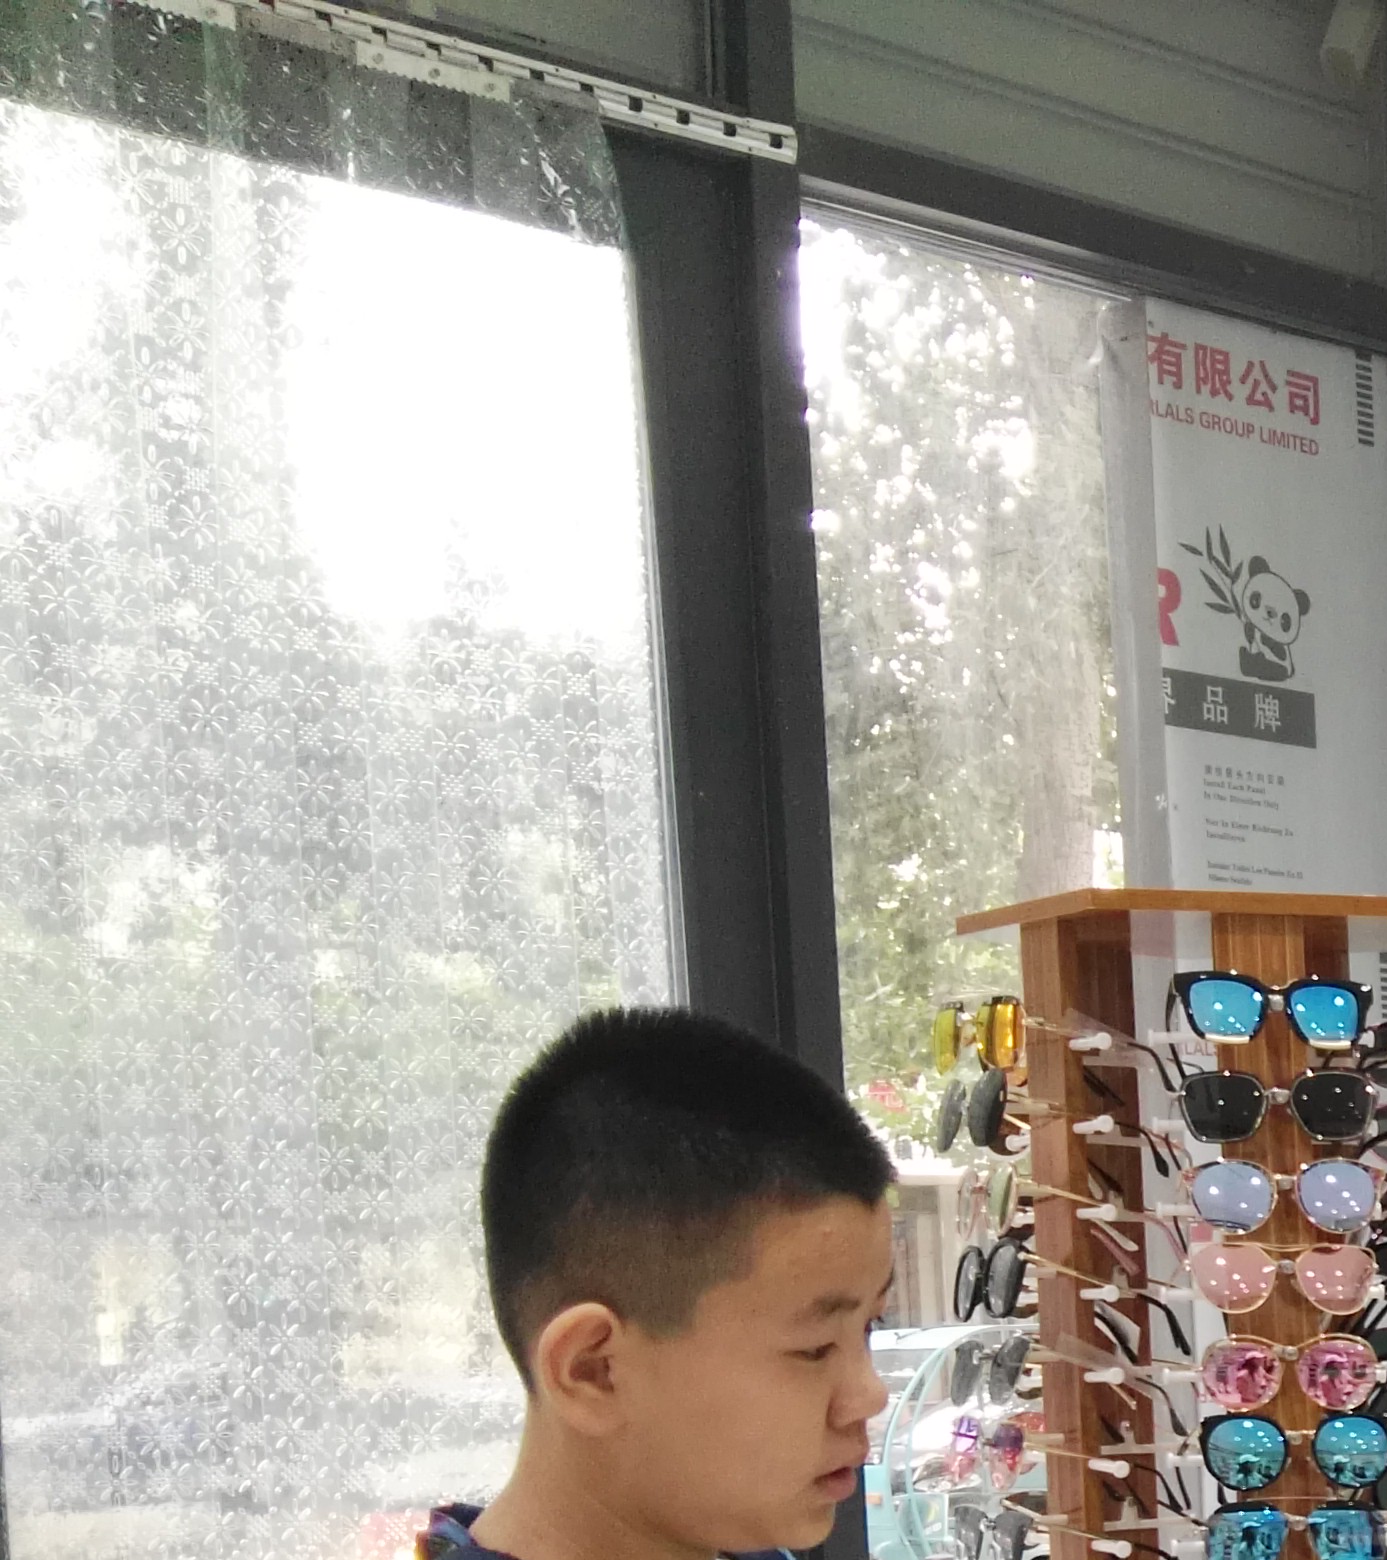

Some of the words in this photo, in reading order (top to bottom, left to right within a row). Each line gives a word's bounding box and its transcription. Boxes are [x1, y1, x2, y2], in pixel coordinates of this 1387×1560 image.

[1146, 332, 1320, 425] 有限公司
[1200, 411, 1255, 438] GROUP
[1260, 426, 1320, 455] LIMITED
